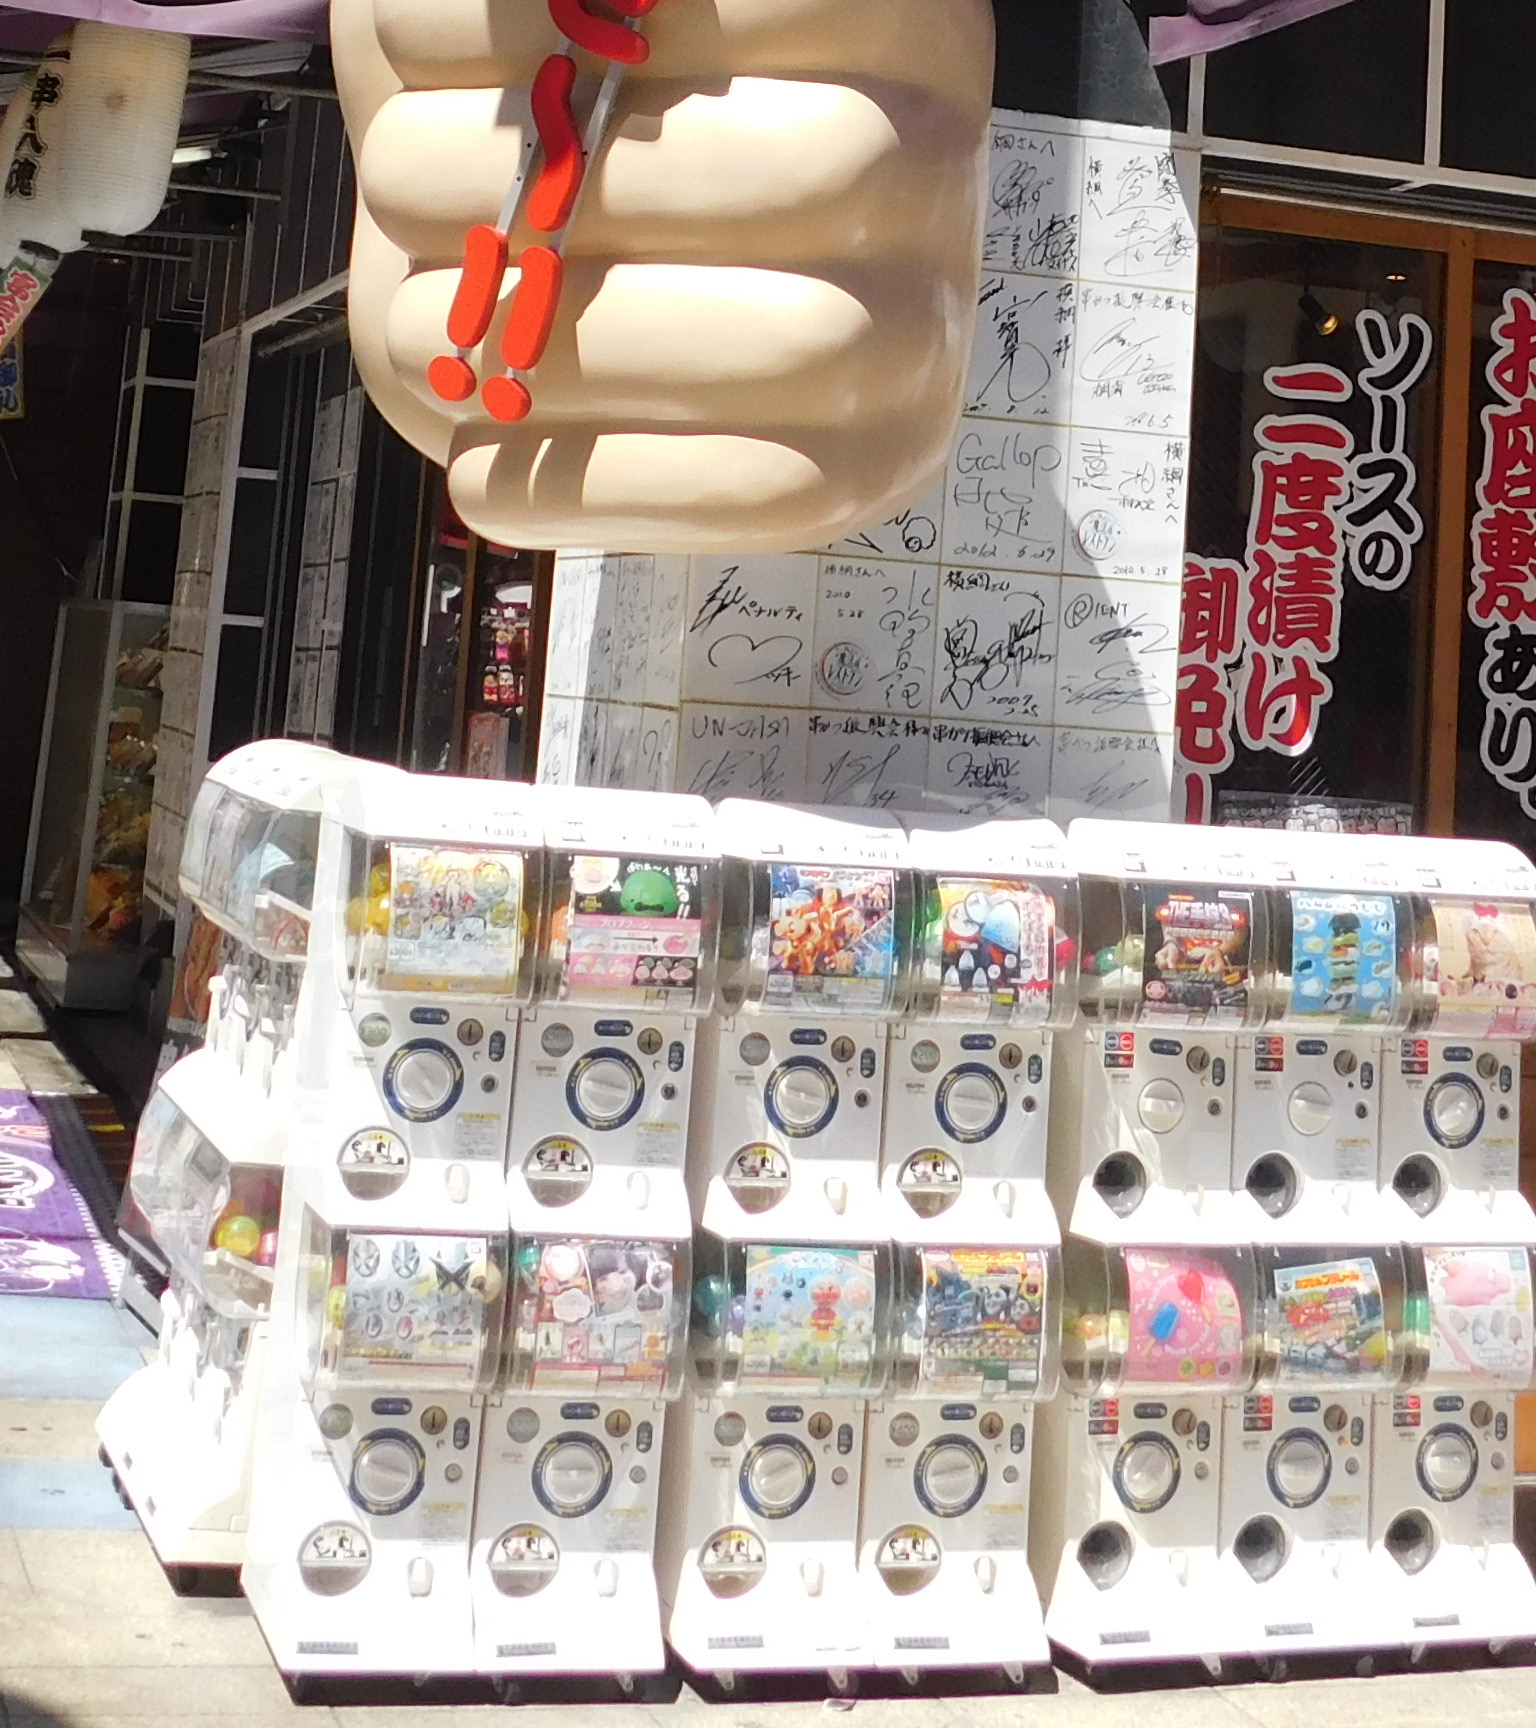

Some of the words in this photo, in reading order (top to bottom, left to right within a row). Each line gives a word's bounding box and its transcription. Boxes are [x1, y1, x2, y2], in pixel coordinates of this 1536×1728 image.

[1246, 370, 1346, 747] 二度漬け
[1359, 314, 1428, 584] ソースの
